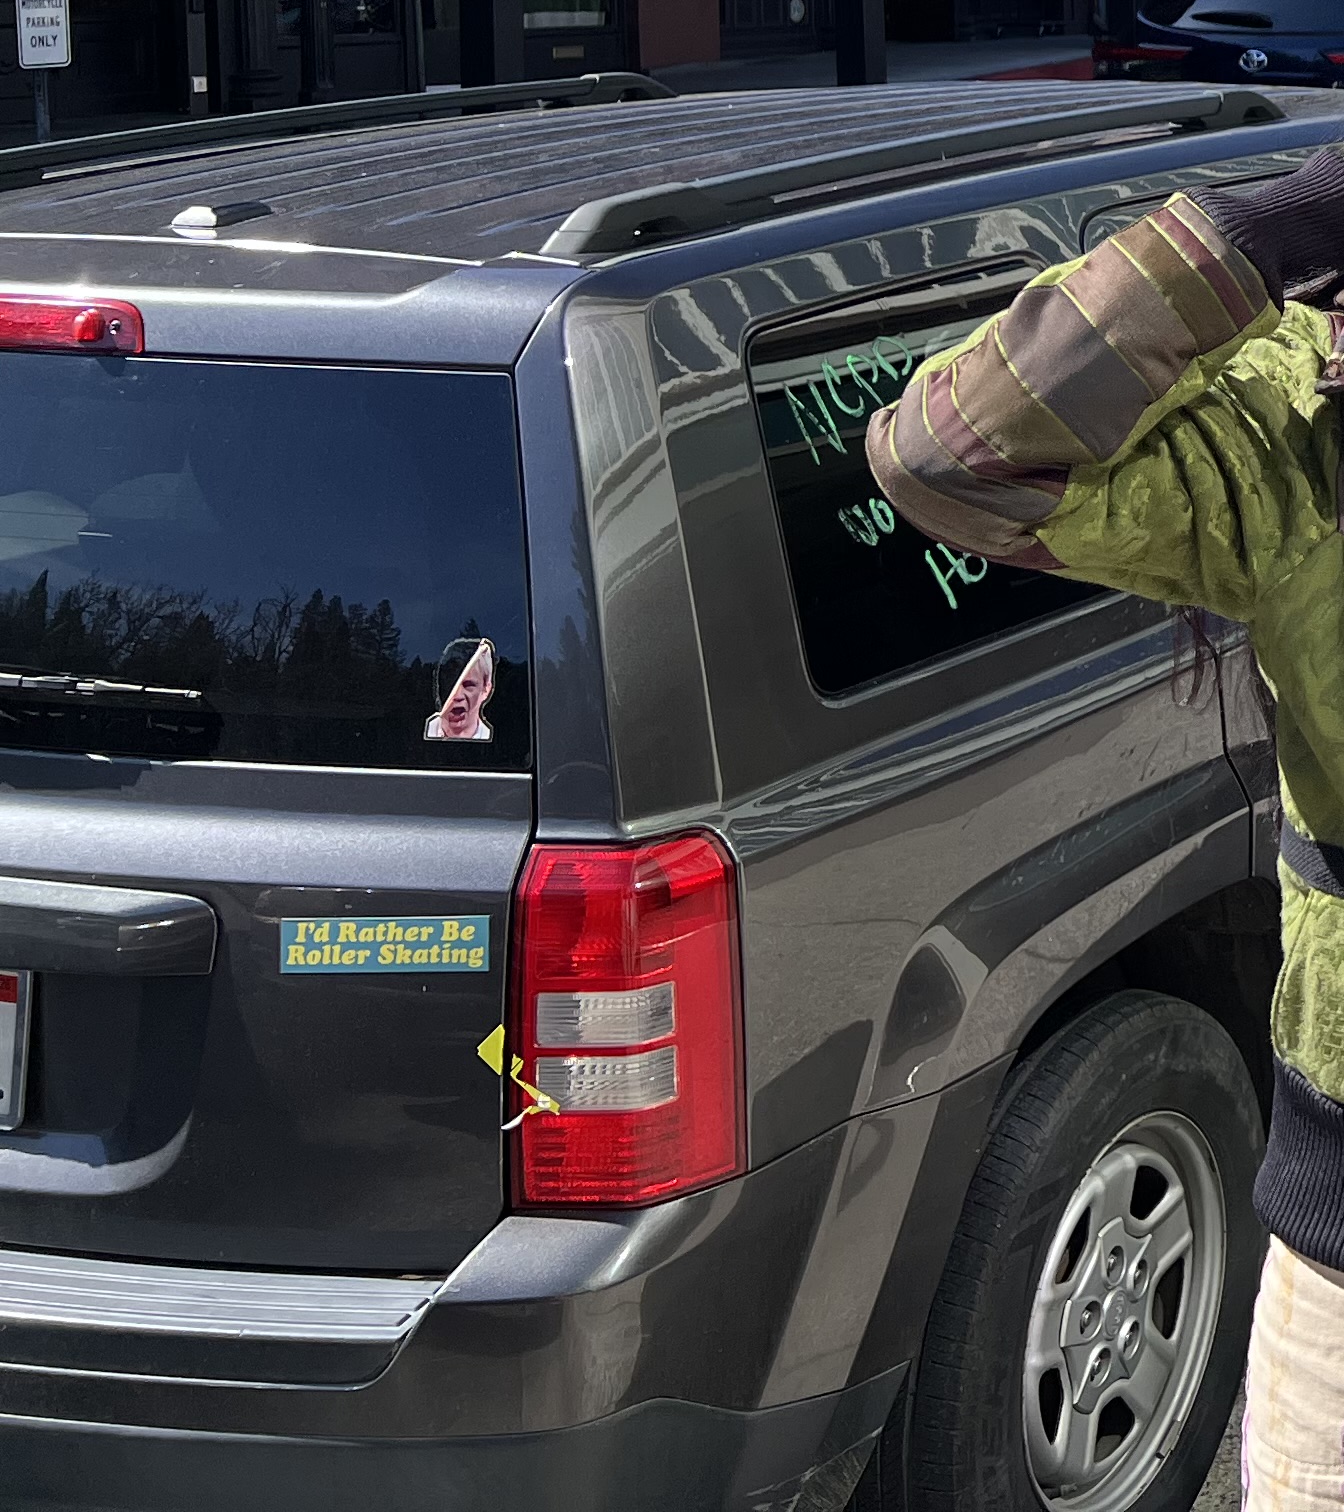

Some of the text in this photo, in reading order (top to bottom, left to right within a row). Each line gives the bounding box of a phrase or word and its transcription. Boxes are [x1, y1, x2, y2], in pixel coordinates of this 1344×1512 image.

[26, 16, 60, 28] PARKING
[30, 35, 58, 48] ONLY
[295, 920, 476, 943] I'd Rather Be
[286, 943, 484, 968] Roller Skating
